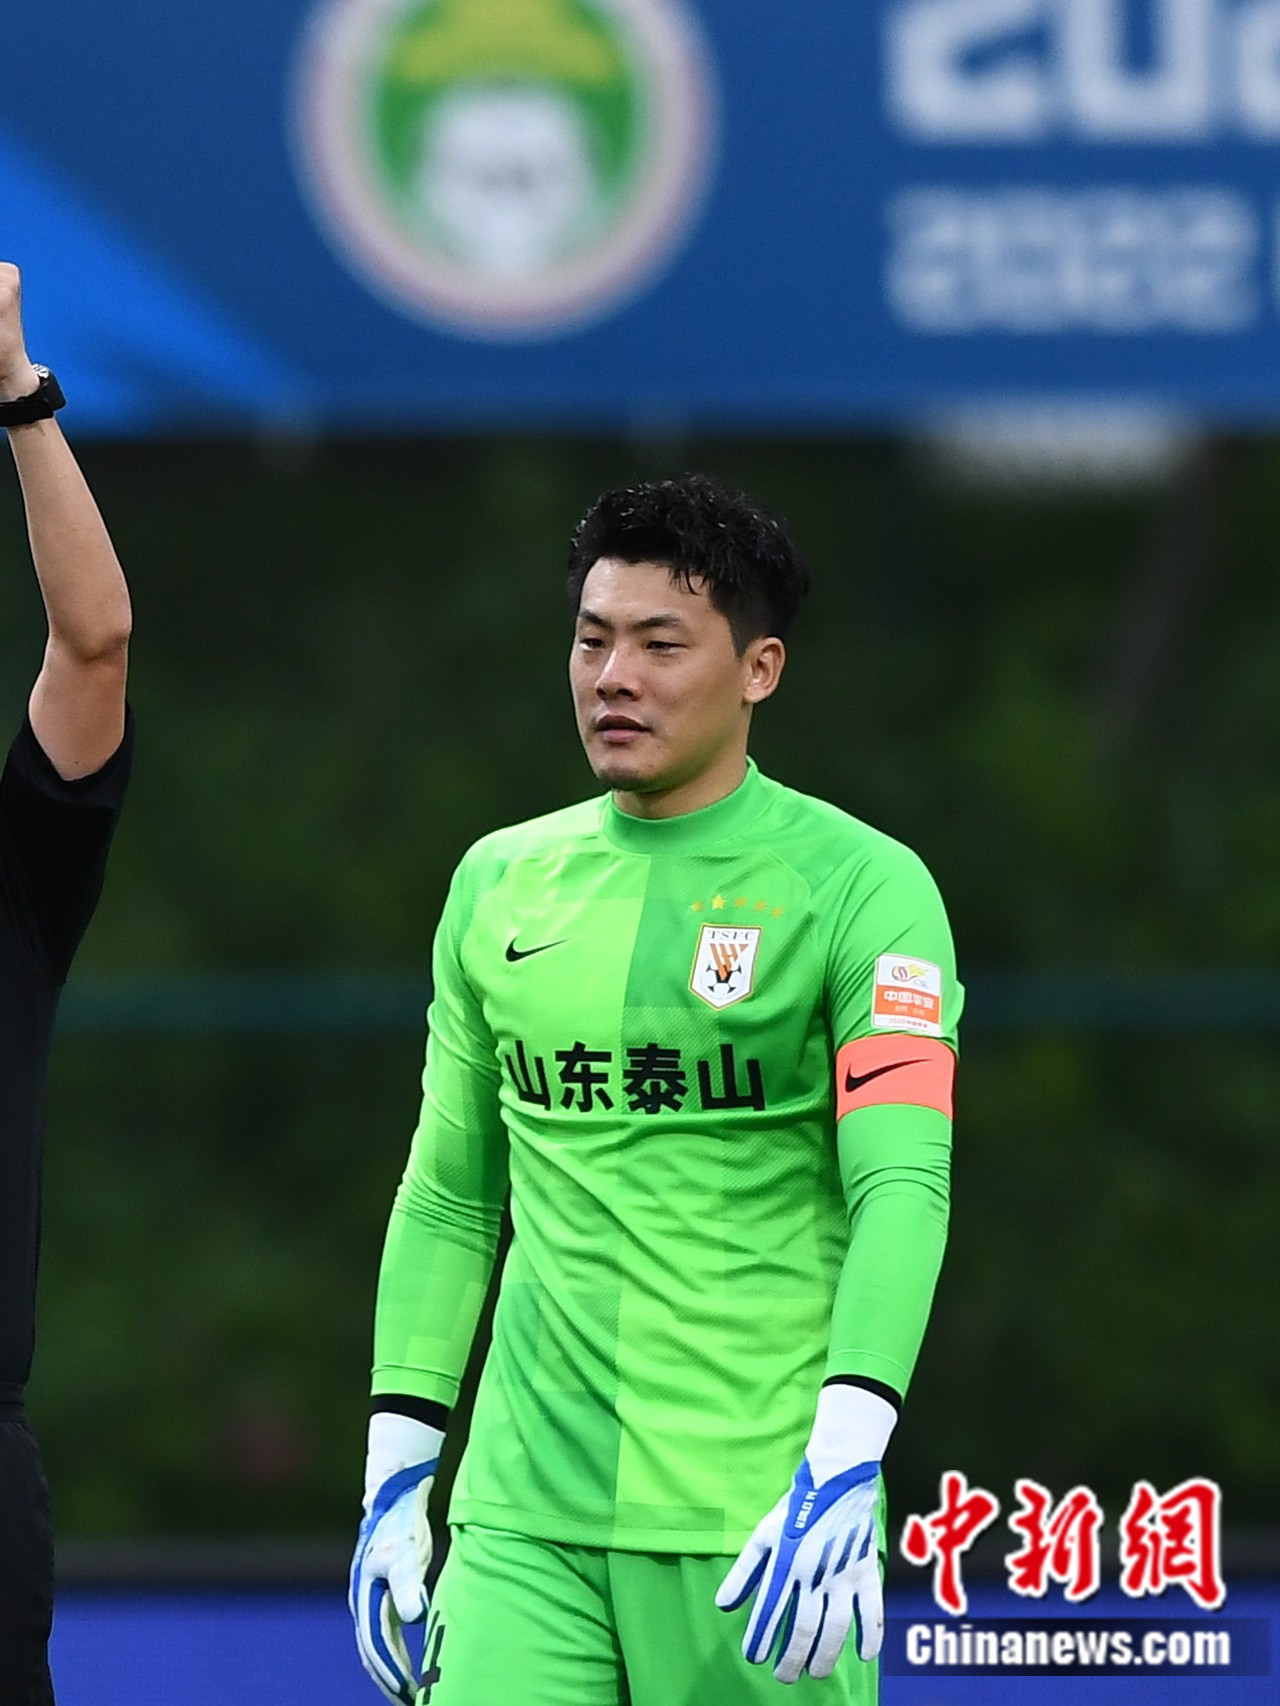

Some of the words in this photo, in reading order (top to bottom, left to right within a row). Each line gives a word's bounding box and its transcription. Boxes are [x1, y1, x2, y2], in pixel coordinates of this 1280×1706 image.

[708, 930, 754, 941] TSFC
[505, 1040, 766, 1115] 山东泰山
